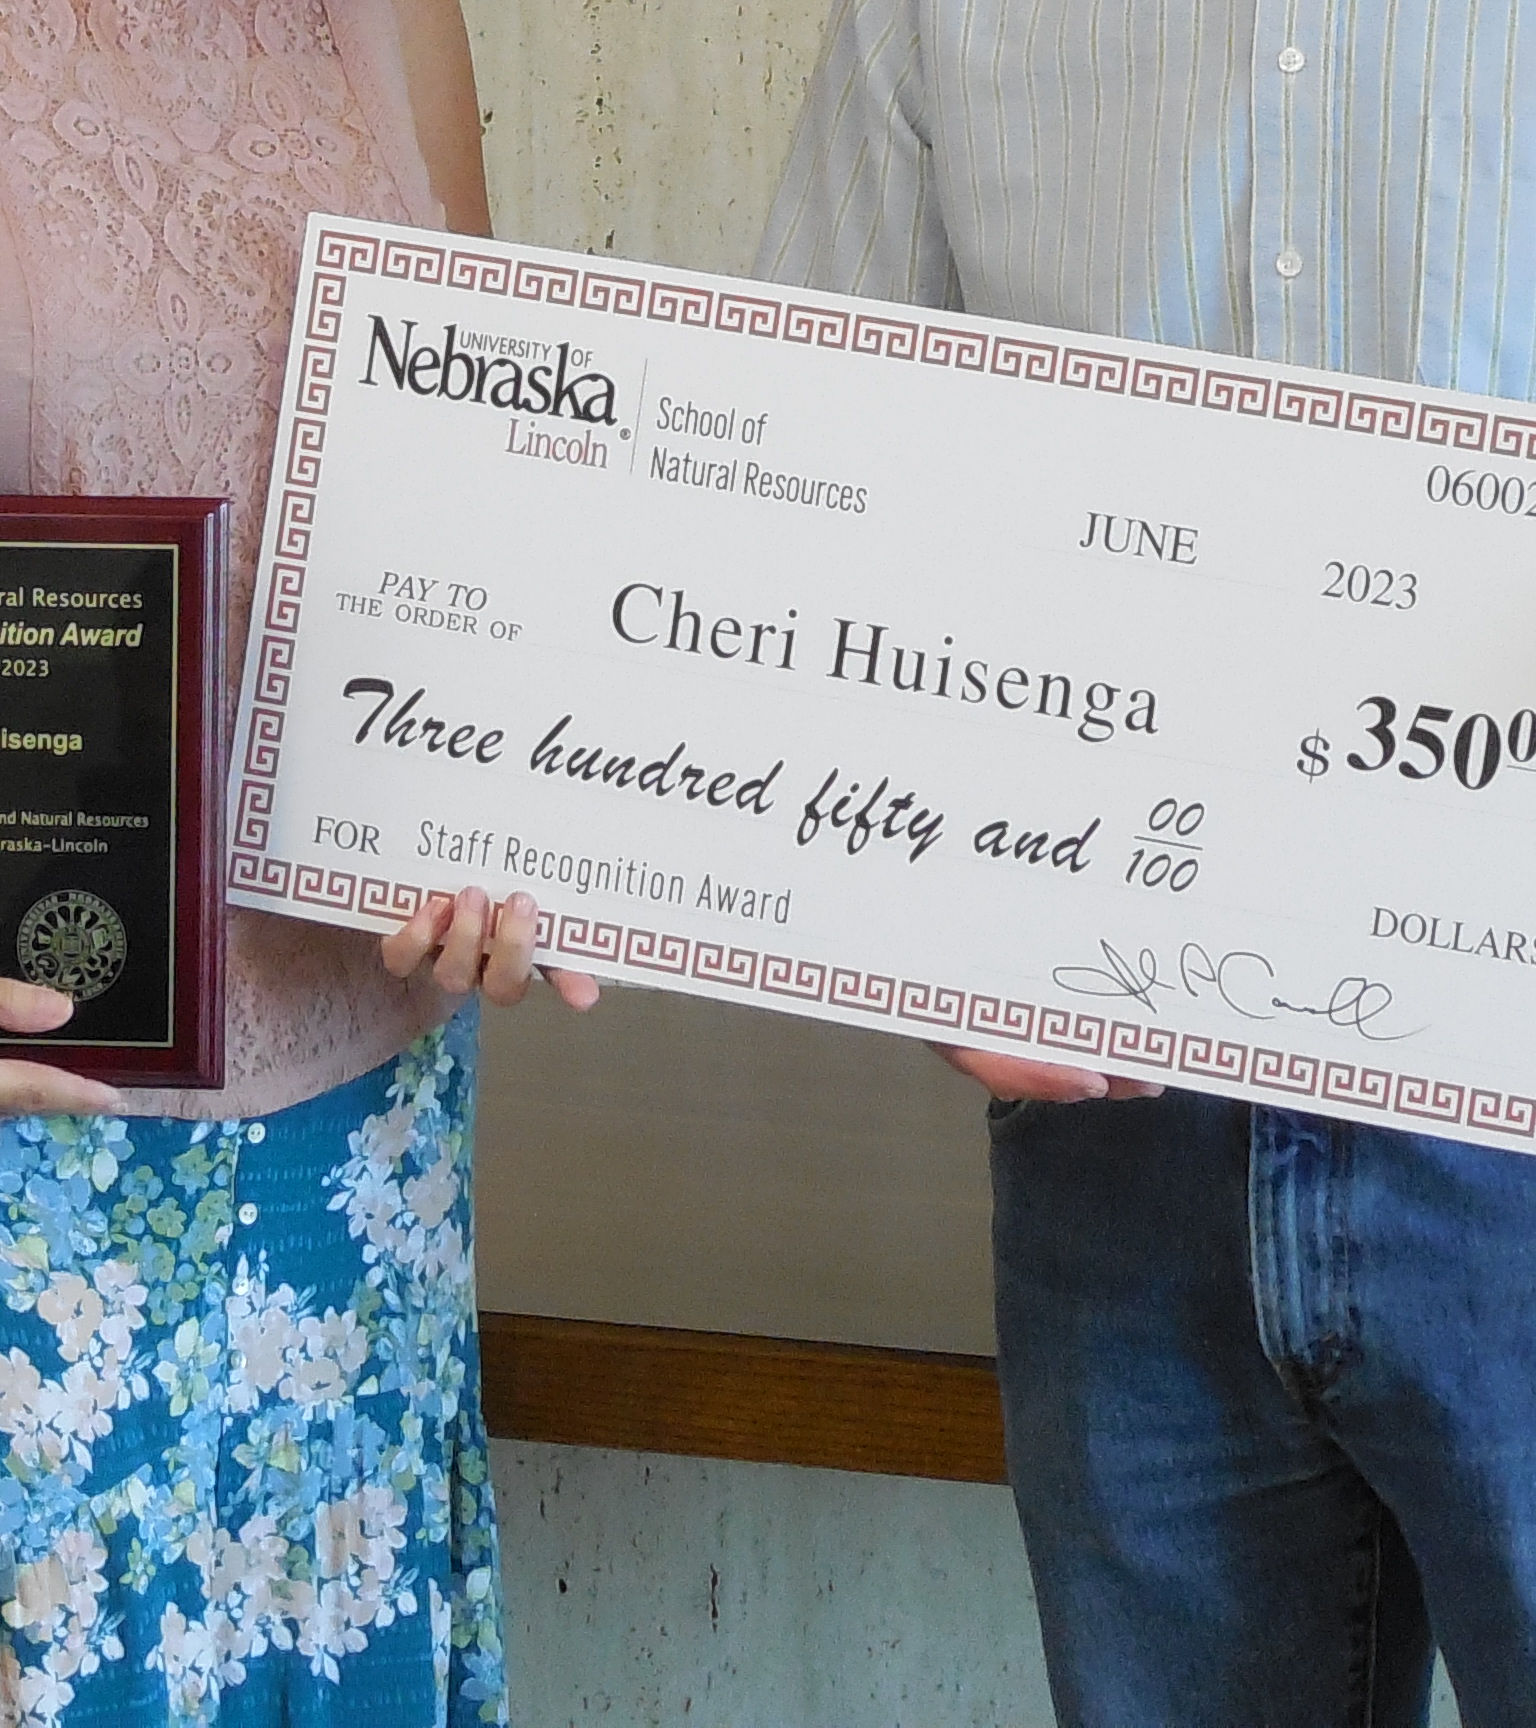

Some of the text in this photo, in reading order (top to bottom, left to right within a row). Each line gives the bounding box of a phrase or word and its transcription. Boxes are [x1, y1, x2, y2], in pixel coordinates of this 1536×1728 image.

[358, 314, 618, 426] Nebraska
[460, 331, 593, 367] UNIVERSITY OF
[505, 418, 608, 469] Lincoln
[656, 397, 768, 445] School of
[650, 447, 868, 514] Natural Resources
[1079, 512, 1419, 610] JUNE 2023
[32, 588, 142, 610] Resources
[378, 572, 488, 611] PAY TO
[60, 622, 142, 647] Award
[336, 593, 523, 641] THE ORDER OF
[0, 659, 49, 677] 2023
[611, 583, 1158, 742] Cheri Huisenga
[343, 678, 504, 764] Three
[530, 715, 783, 815] hundred
[795, 768, 944, 862] fifty
[974, 816, 1101, 874] and
[21, 811, 72, 826] Natural
[77, 812, 148, 828] Resources
[313, 817, 792, 924] FOR Staff Recognition Award
